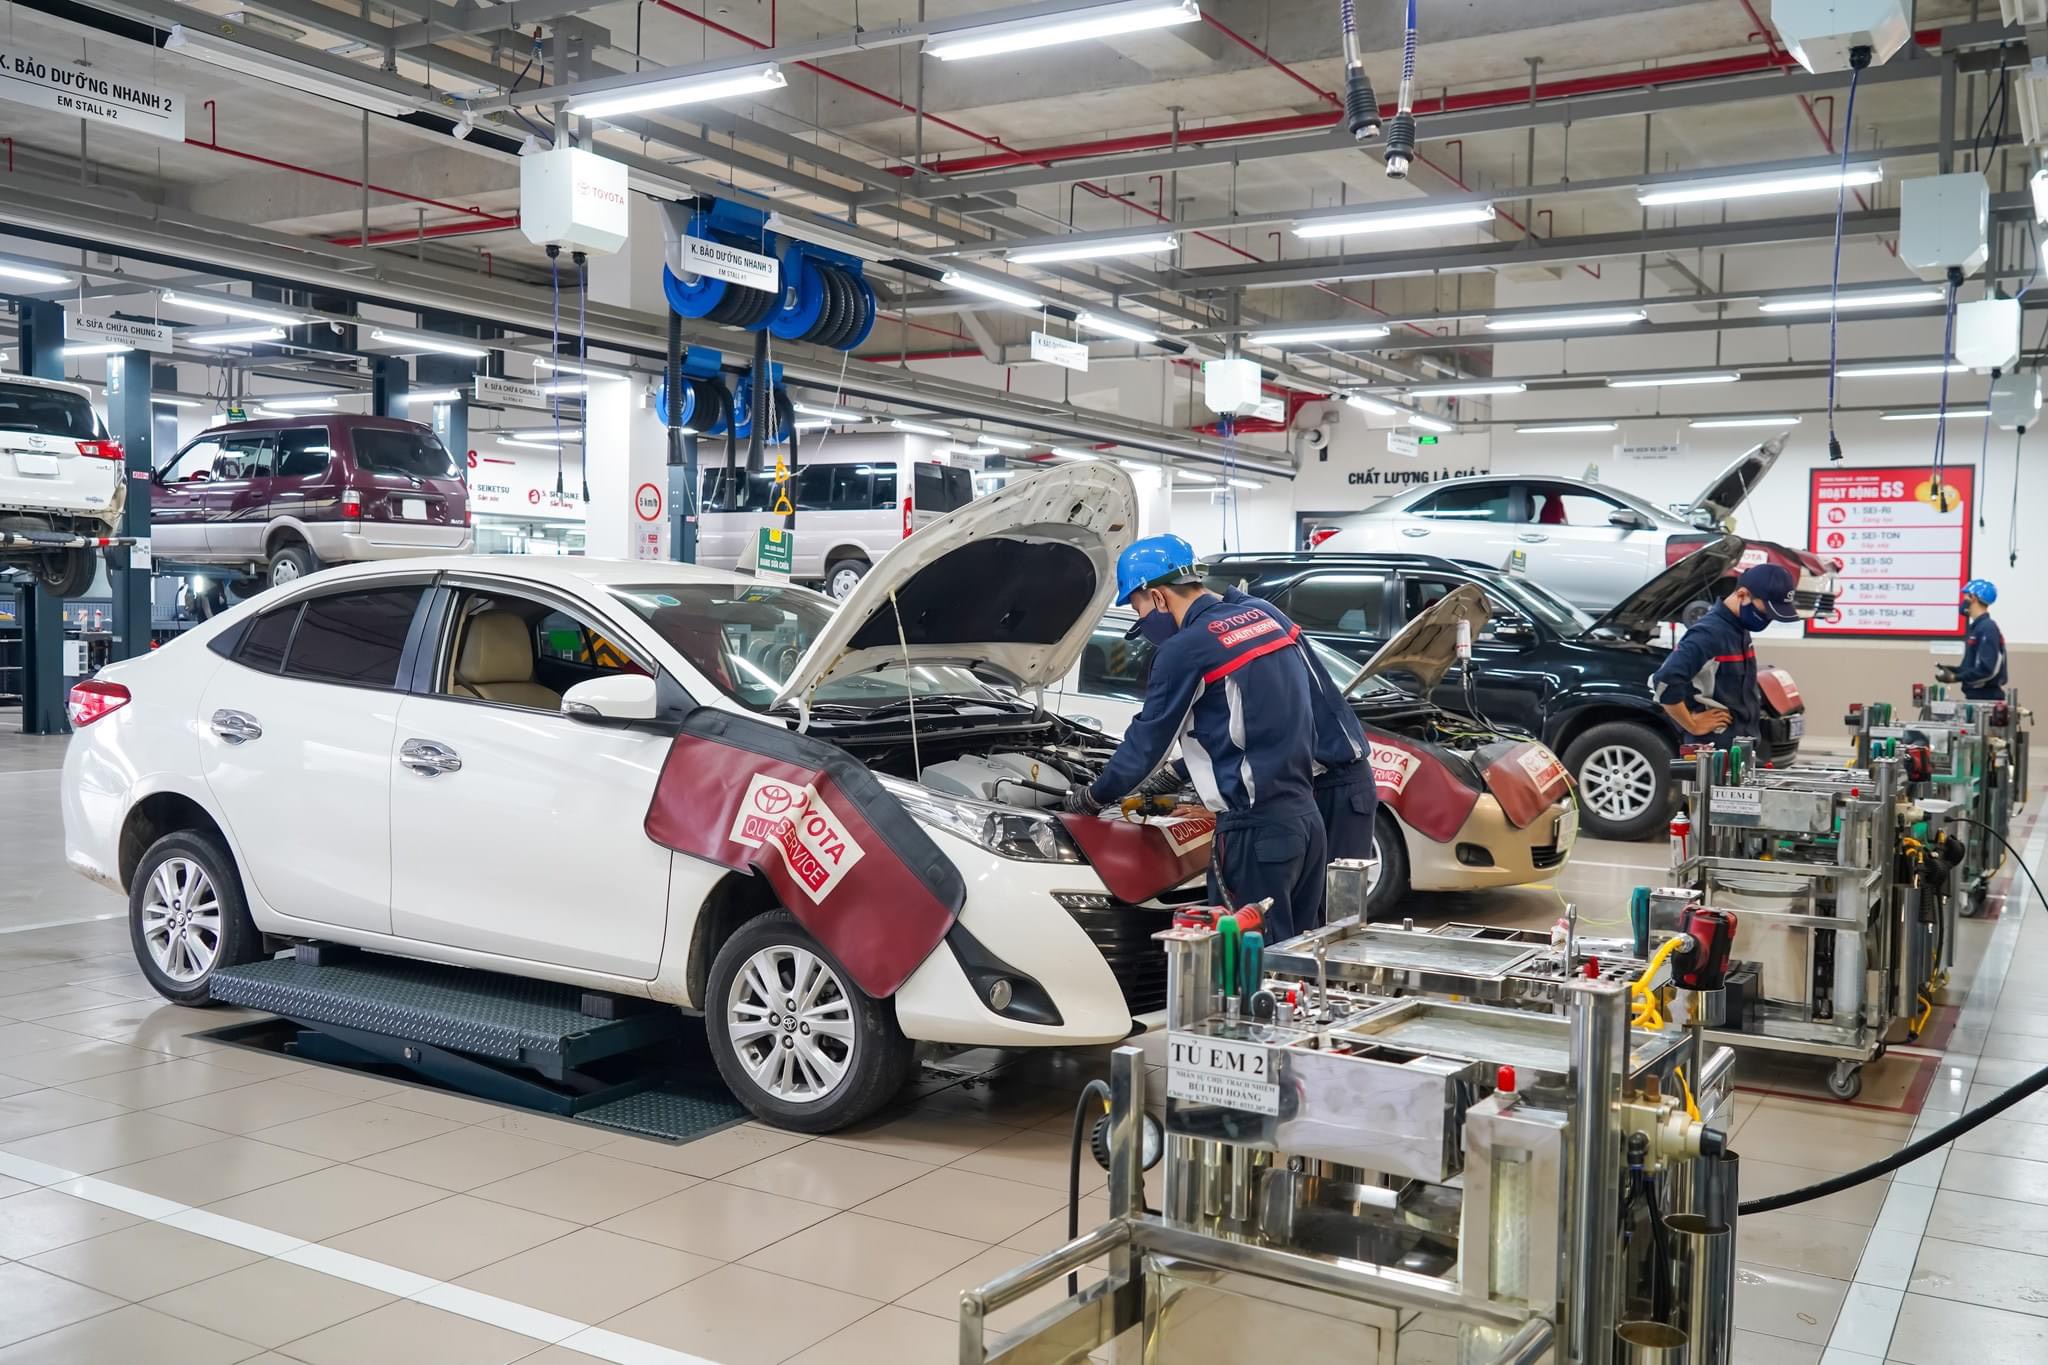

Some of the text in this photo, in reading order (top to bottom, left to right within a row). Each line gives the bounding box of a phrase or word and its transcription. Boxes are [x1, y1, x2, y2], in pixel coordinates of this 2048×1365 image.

[15, 57, 46, 79] BẢO
[51, 68, 108, 95] DƯỠNG
[113, 84, 160, 109] NHANH
[164, 98, 173, 112] 2
[57, 95, 118, 119] EM STALL #2
[592, 187, 624, 205] TOYOTA
[691, 244, 773, 273] K. BẢO DƯỠNG NHANH 3
[76, 318, 85, 326] K.
[86, 318, 104, 329] SỬA
[130, 326, 156, 337] CHUNG
[157, 330, 163, 338] 2
[1348, 467, 1381, 484] CHẤT
[1384, 470, 1429, 486] LƯỢNG
[477, 484, 510, 494] SEIKETSU
[1880, 481, 1904, 498] 5S
[640, 498, 644, 506] 5
[1225, 609, 1266, 626] TOYOT
[1372, 748, 1409, 771] YOTA
[1730, 791, 1745, 799] EM
[792, 791, 847, 865] OYOTA
[777, 819, 825, 886] SERVICE
[1171, 1040, 1264, 1075] TỦ EM 2
